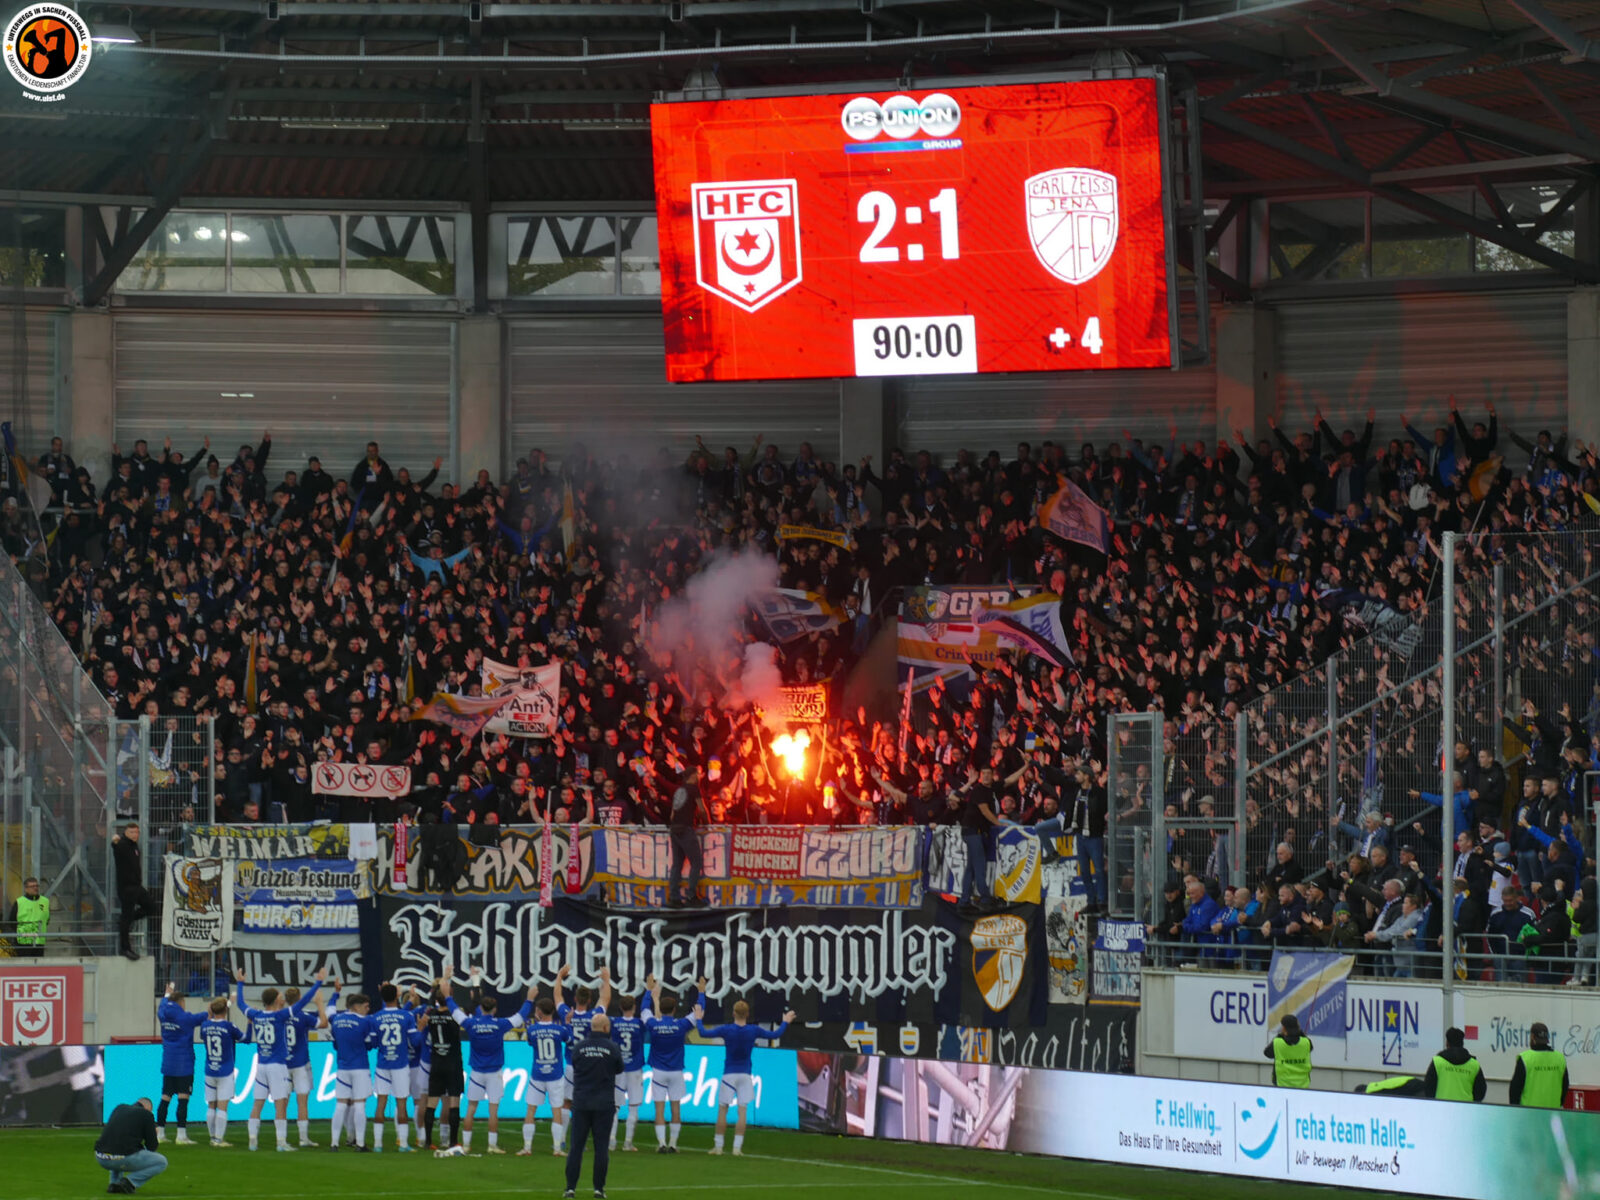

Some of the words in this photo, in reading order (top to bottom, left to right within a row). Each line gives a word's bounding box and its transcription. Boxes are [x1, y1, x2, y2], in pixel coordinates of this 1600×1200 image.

[850, 111, 878, 127] PS
[883, 106, 953, 127] UNION
[923, 138, 963, 149] GROUP
[1031, 175, 1068, 196] CARL
[1071, 173, 1110, 195] ZEISS
[706, 190, 784, 215] HFC
[1047, 197, 1098, 212] JENA
[857, 188, 960, 263] 2:1
[873, 324, 963, 359] 90:00
[1081, 317, 1104, 354] 4
[949, 589, 1033, 616] GER
[510, 700, 544, 713] Anti
[510, 722, 545, 733] ACTION
[191, 834, 316, 860] WEIMAR
[605, 829, 727, 878] HORA
[733, 833, 801, 852] SCHICKERIA
[374, 832, 594, 890] HAKIRI
[732, 851, 799, 871] MÜNCHEN
[252, 867, 297, 889] Letzte
[301, 866, 361, 890] Festung
[885, 881, 923, 907] UNS
[176, 914, 220, 930] GÖSNITZ
[180, 929, 211, 941] AWAY
[981, 936, 1016, 947] JENA
[389, 902, 956, 1001] Schlachtenbummler
[230, 951, 363, 985] ULTRAS
[7, 982, 59, 999] HFC
[1210, 983, 1266, 1026] GERÜ
[1309, 990, 1345, 1031] TRIPTIS
[255, 1023, 275, 1044] 28
[378, 1023, 402, 1046] 23
[437, 1024, 444, 1045] 1
[573, 1026, 585, 1045] 5
[620, 1031, 632, 1052] 3
[206, 1036, 222, 1057] 13
[537, 1037, 556, 1060] 10
[1155, 1098, 1165, 1126] F.
[1168, 1100, 1215, 1136] Hellwig
[1295, 1112, 1326, 1141] reha
[1330, 1113, 1366, 1145] team
[1370, 1117, 1407, 1149] Halle
[1119, 1131, 1132, 1147] Das
[1133, 1132, 1151, 1149] Haus
[1152, 1133, 1164, 1150] für
[1165, 1135, 1180, 1152] Ihre
[1181, 1137, 1223, 1156] Gesundheit
[1295, 1149, 1310, 1165] Wir
[1313, 1151, 1347, 1172] bewegen
[1349, 1155, 1390, 1174] Menschen
